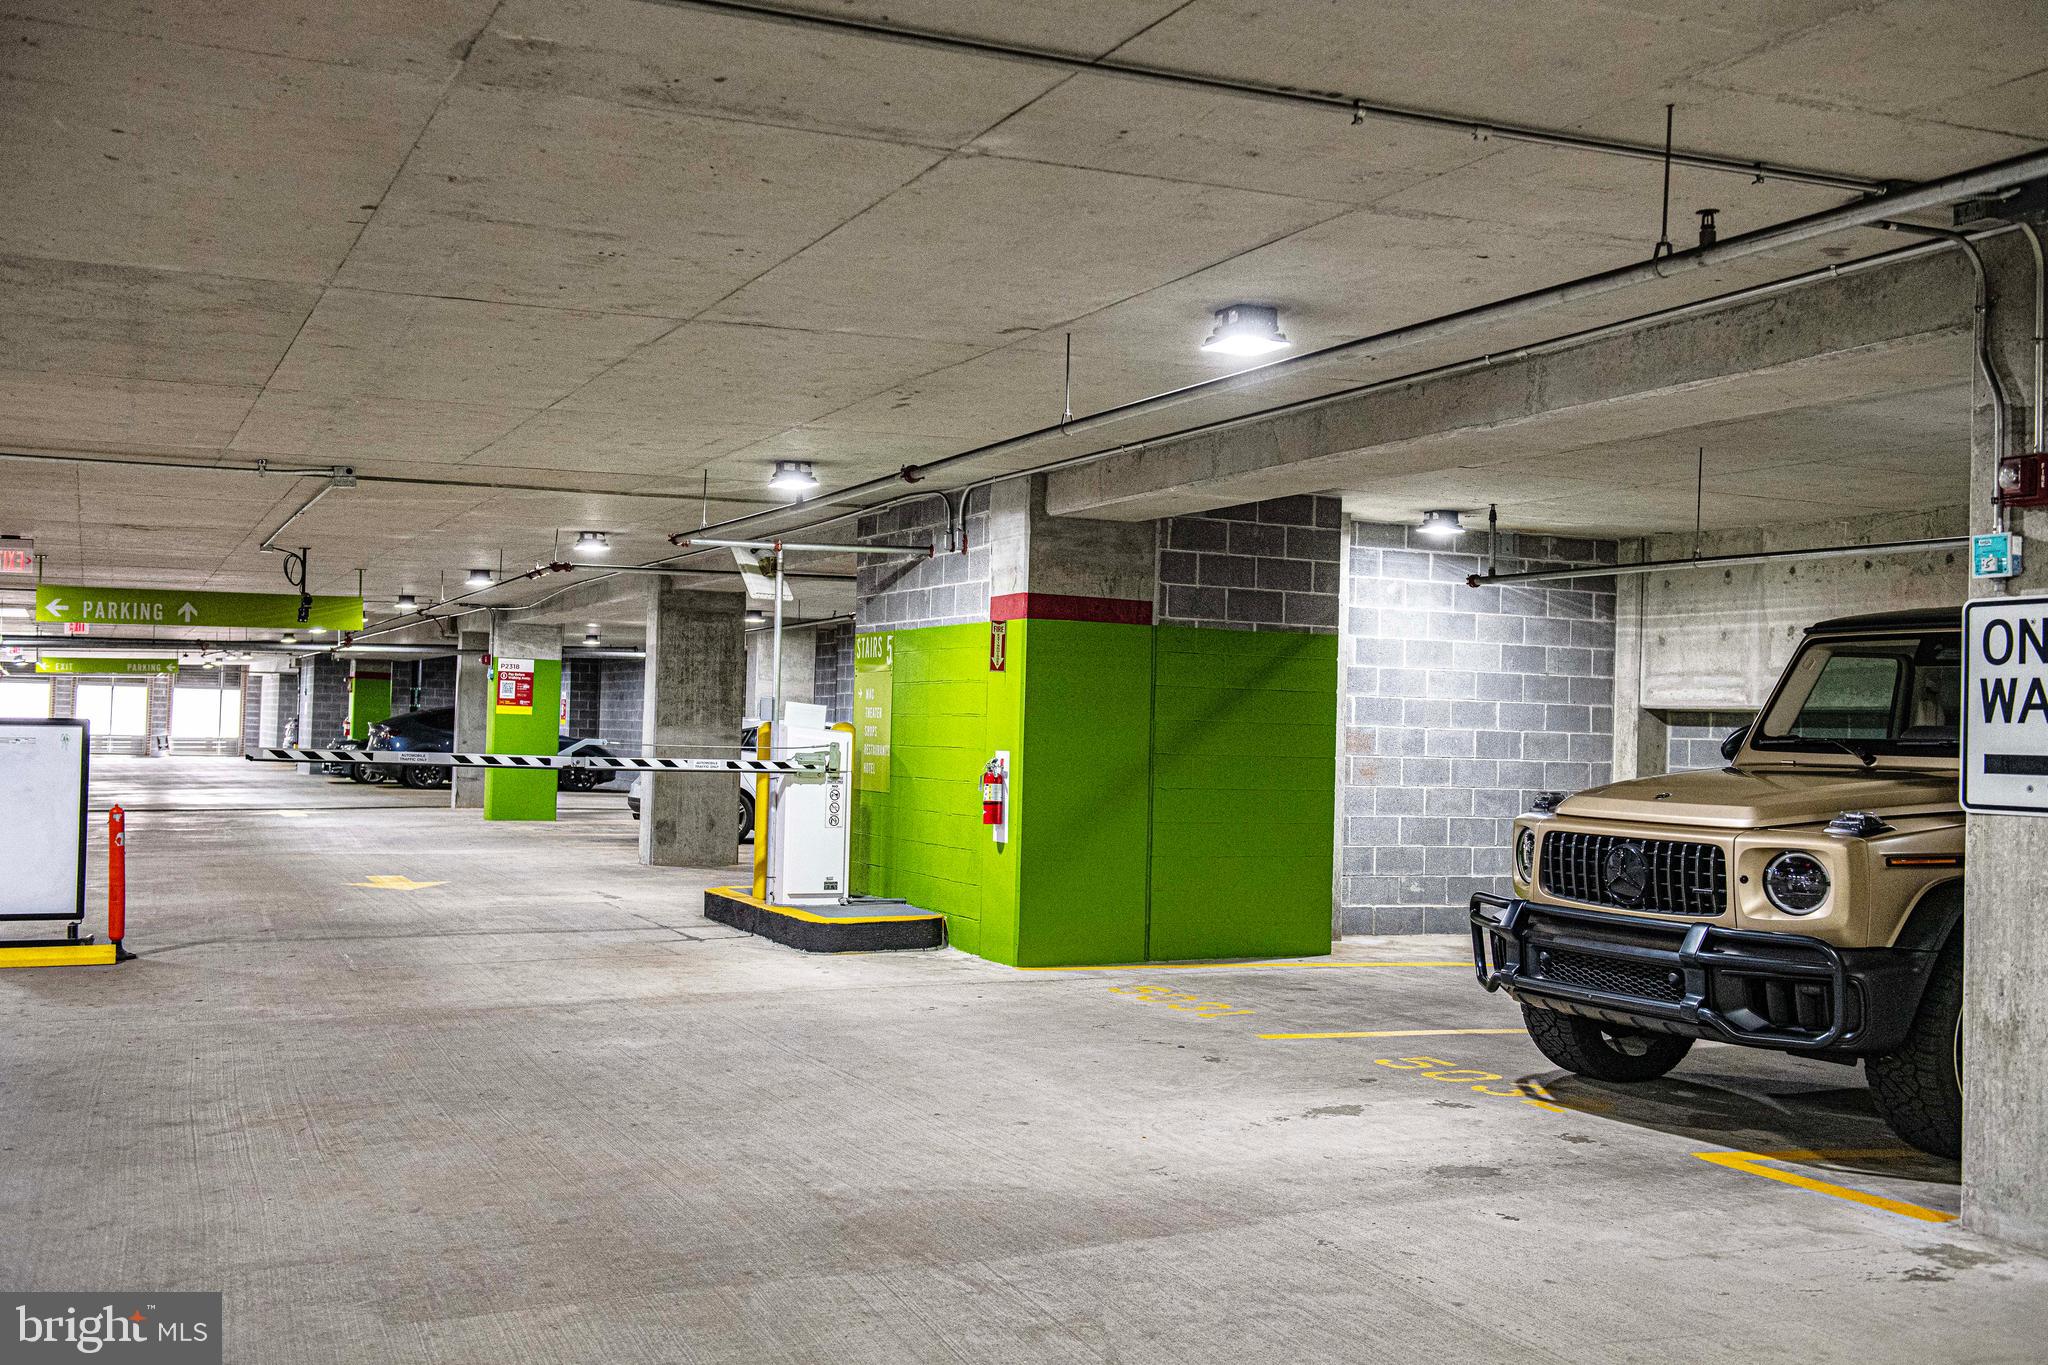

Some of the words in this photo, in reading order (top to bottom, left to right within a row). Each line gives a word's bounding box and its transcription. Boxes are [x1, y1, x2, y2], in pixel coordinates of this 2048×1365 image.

[83, 600, 163, 621] PARKING
[856, 635, 883, 659] STAIRS
[886, 634, 894, 666] 5
[55, 662, 73, 671] EXIT
[127, 663, 161, 672] PARKING
